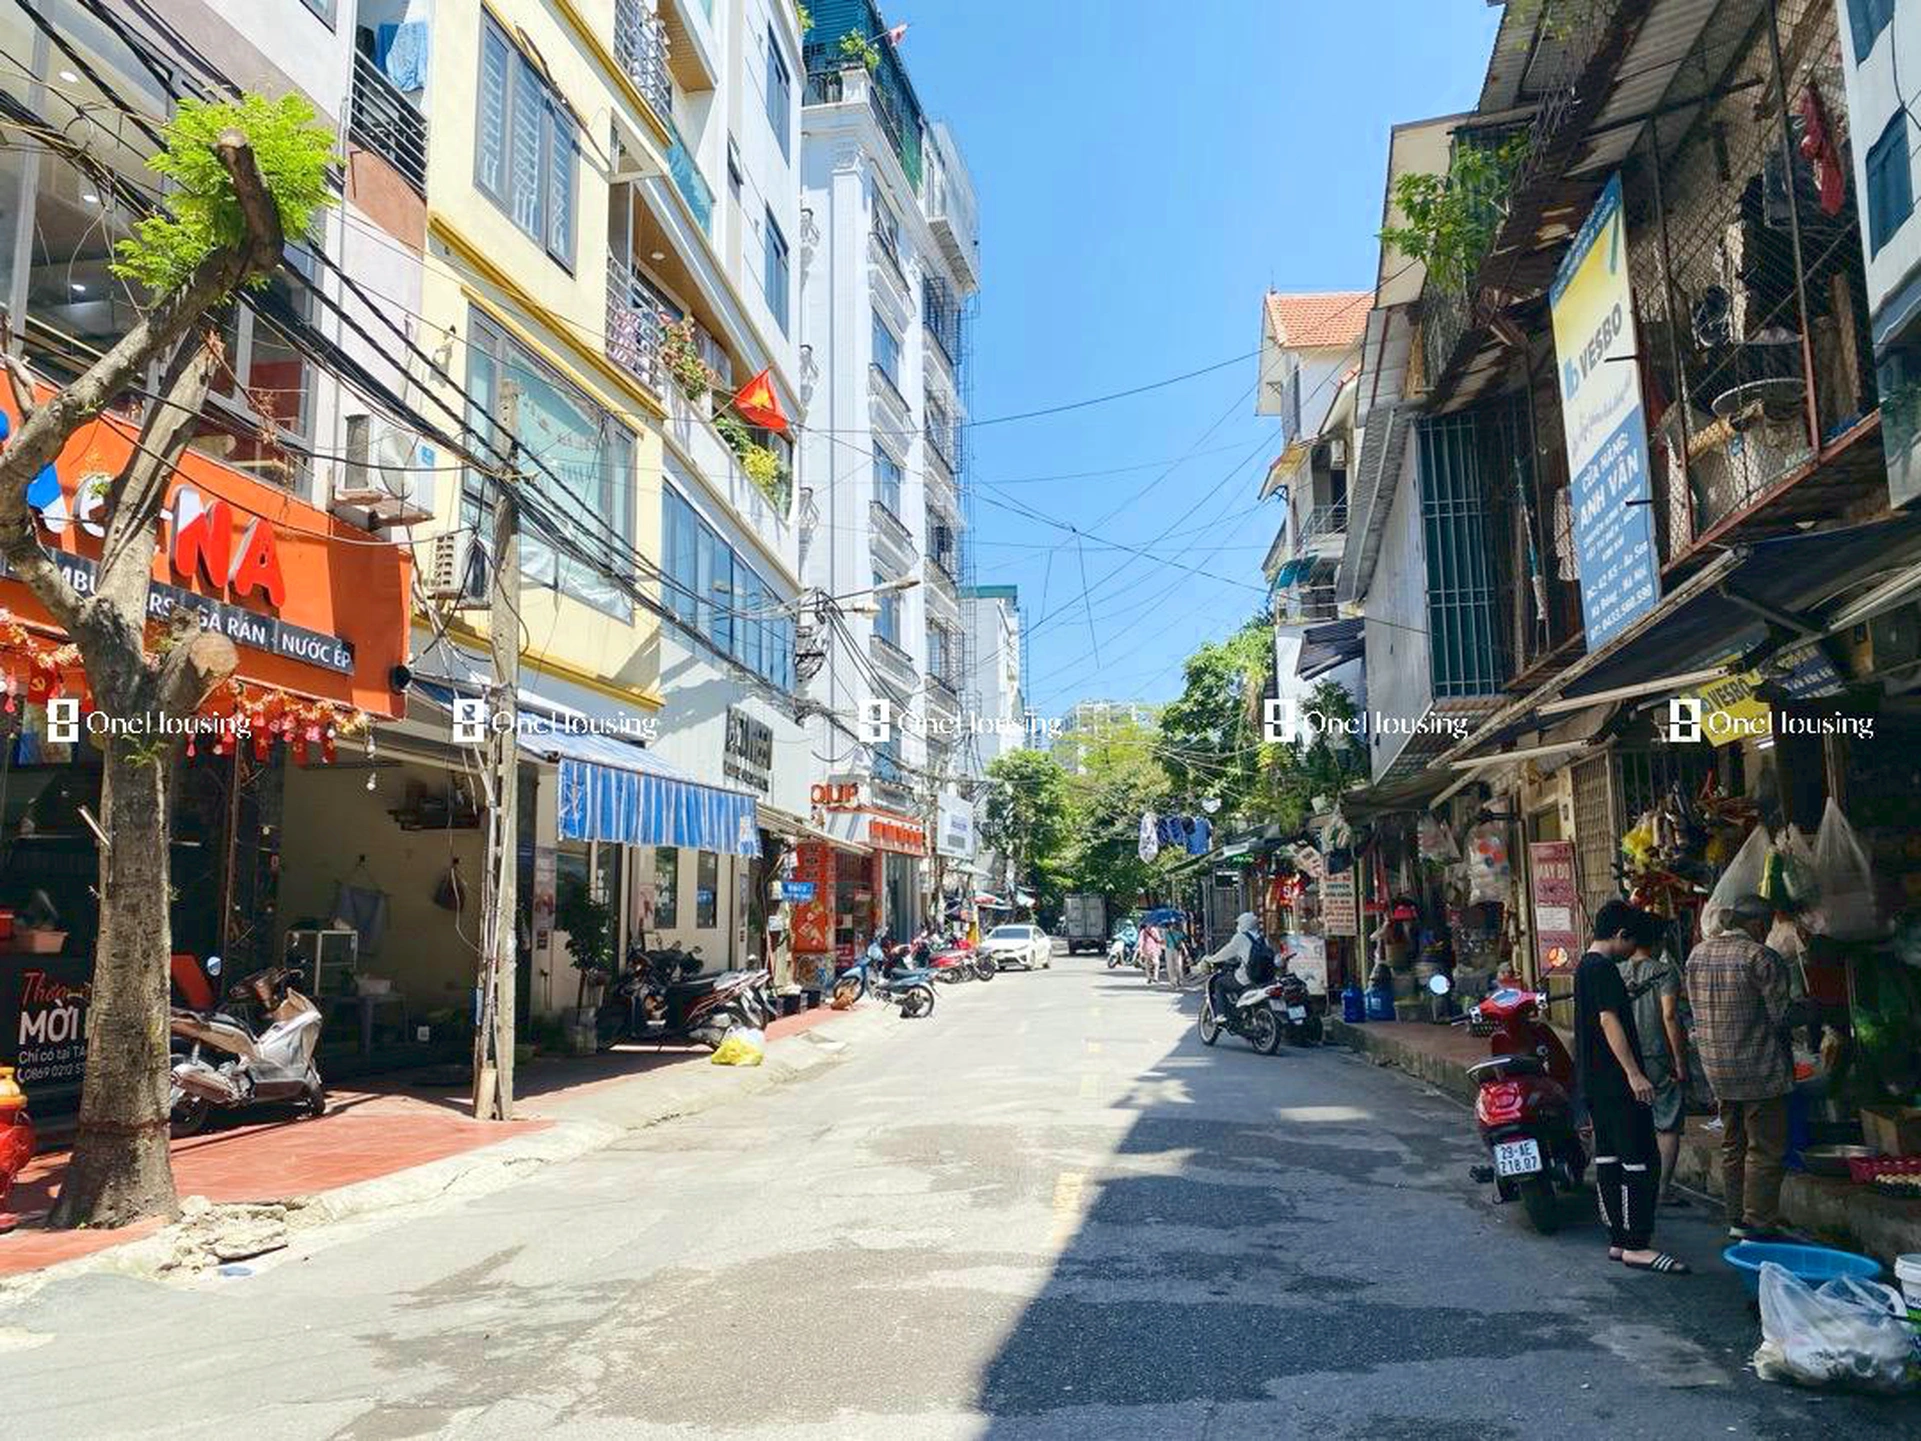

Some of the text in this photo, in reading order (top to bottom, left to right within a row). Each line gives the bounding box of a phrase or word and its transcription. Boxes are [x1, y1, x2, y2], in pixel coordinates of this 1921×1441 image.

[1579, 302, 1622, 380] VESBO
[1580, 484, 1605, 531] ANH
[227, 615, 266, 645] RÁN
[282, 633, 330, 663] NƯỚC
[334, 644, 352, 668] ÉP
[1708, 677, 1752, 710] VESBO
